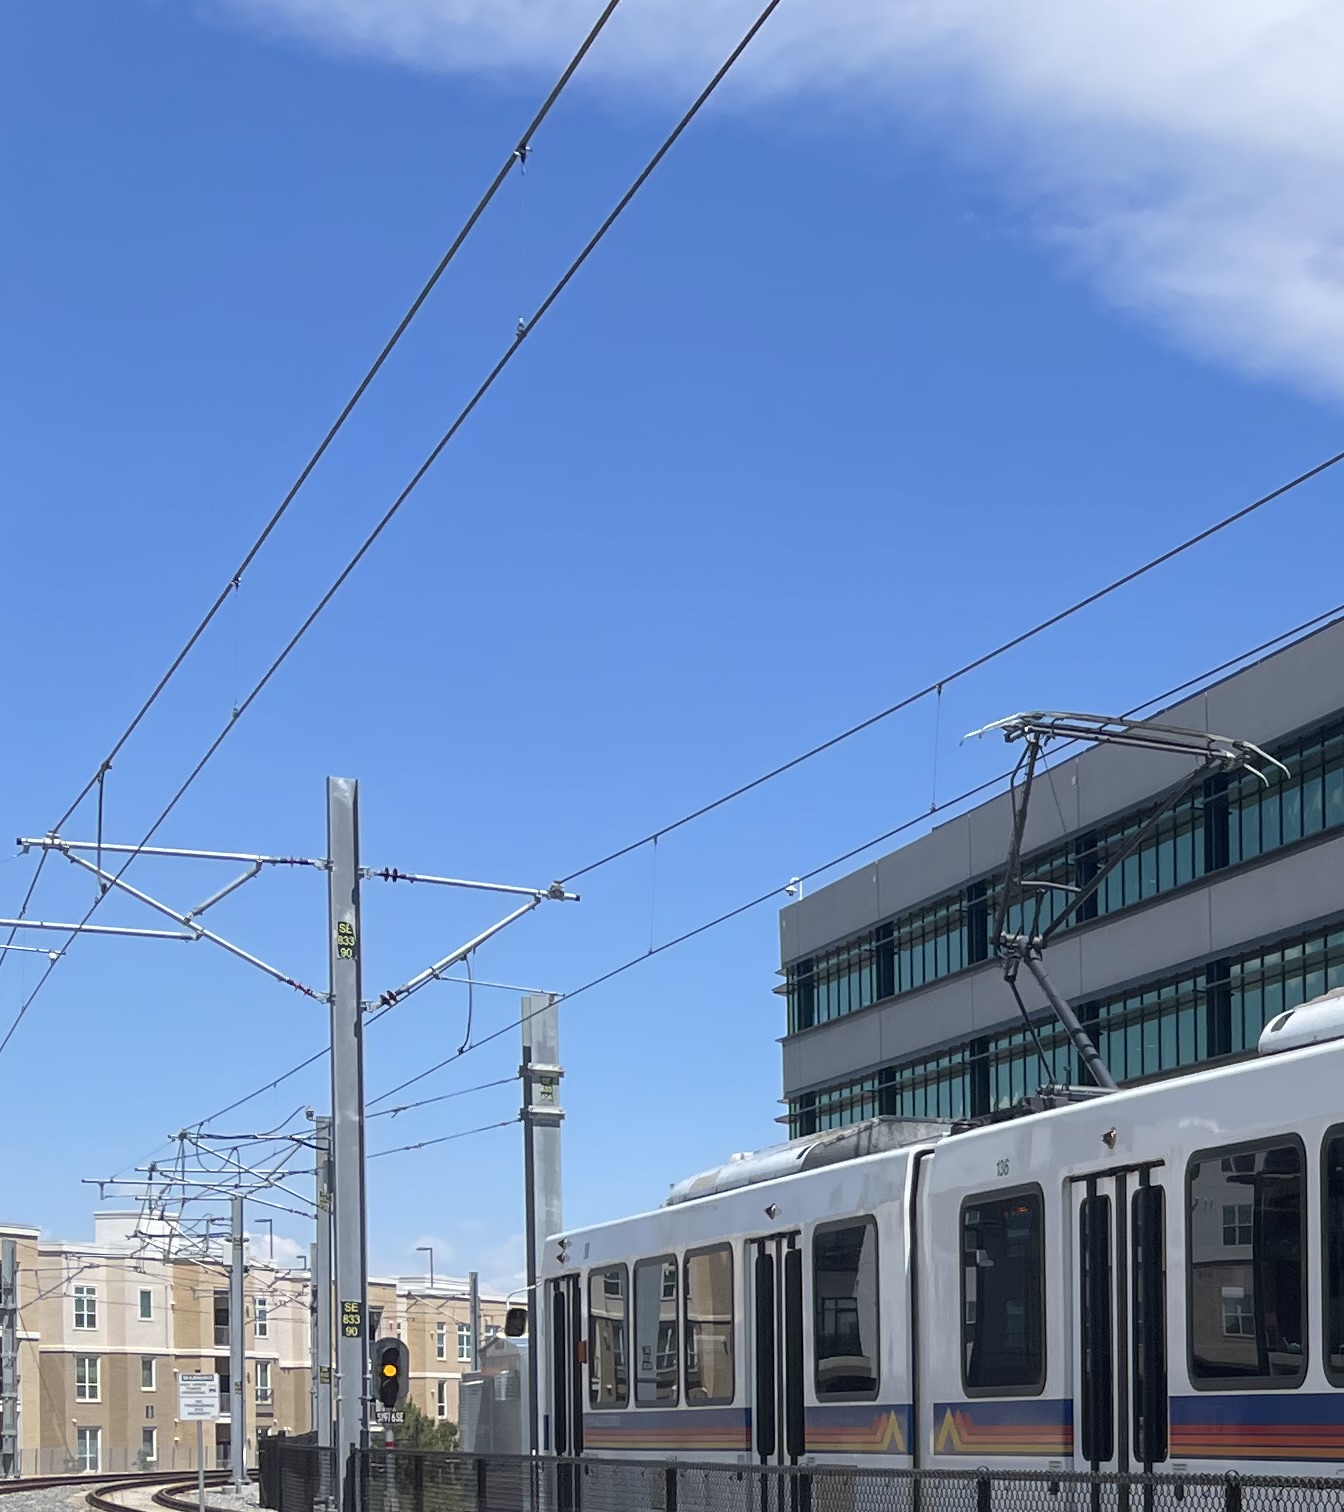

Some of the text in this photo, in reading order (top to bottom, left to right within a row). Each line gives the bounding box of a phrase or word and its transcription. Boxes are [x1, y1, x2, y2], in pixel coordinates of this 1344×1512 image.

[996, 1158, 1010, 1177] 136
[344, 1302, 359, 1313] SE
[343, 1314, 361, 1325] 833
[345, 1326, 358, 1337] 90
